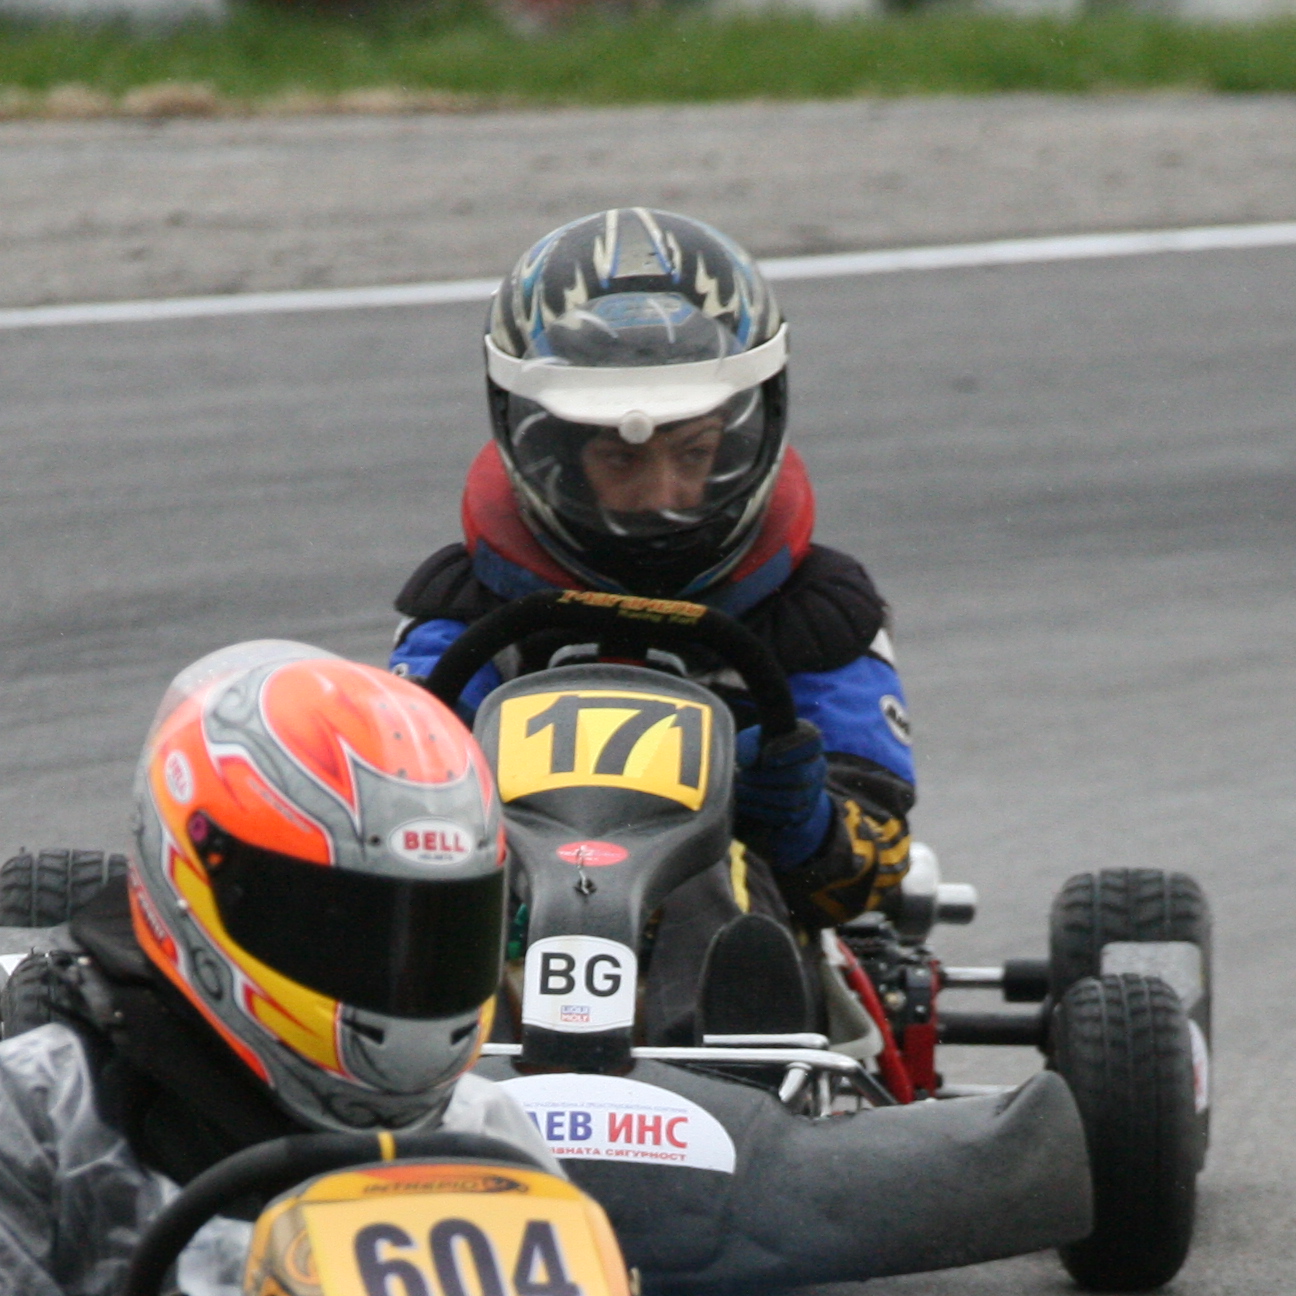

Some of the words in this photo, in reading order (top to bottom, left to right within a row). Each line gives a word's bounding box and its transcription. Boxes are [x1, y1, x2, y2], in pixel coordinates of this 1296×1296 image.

[526, 694, 705, 790] 171
[403, 831, 466, 853] BELL
[538, 951, 622, 998] BG
[608, 1111, 689, 1149] ИНС
